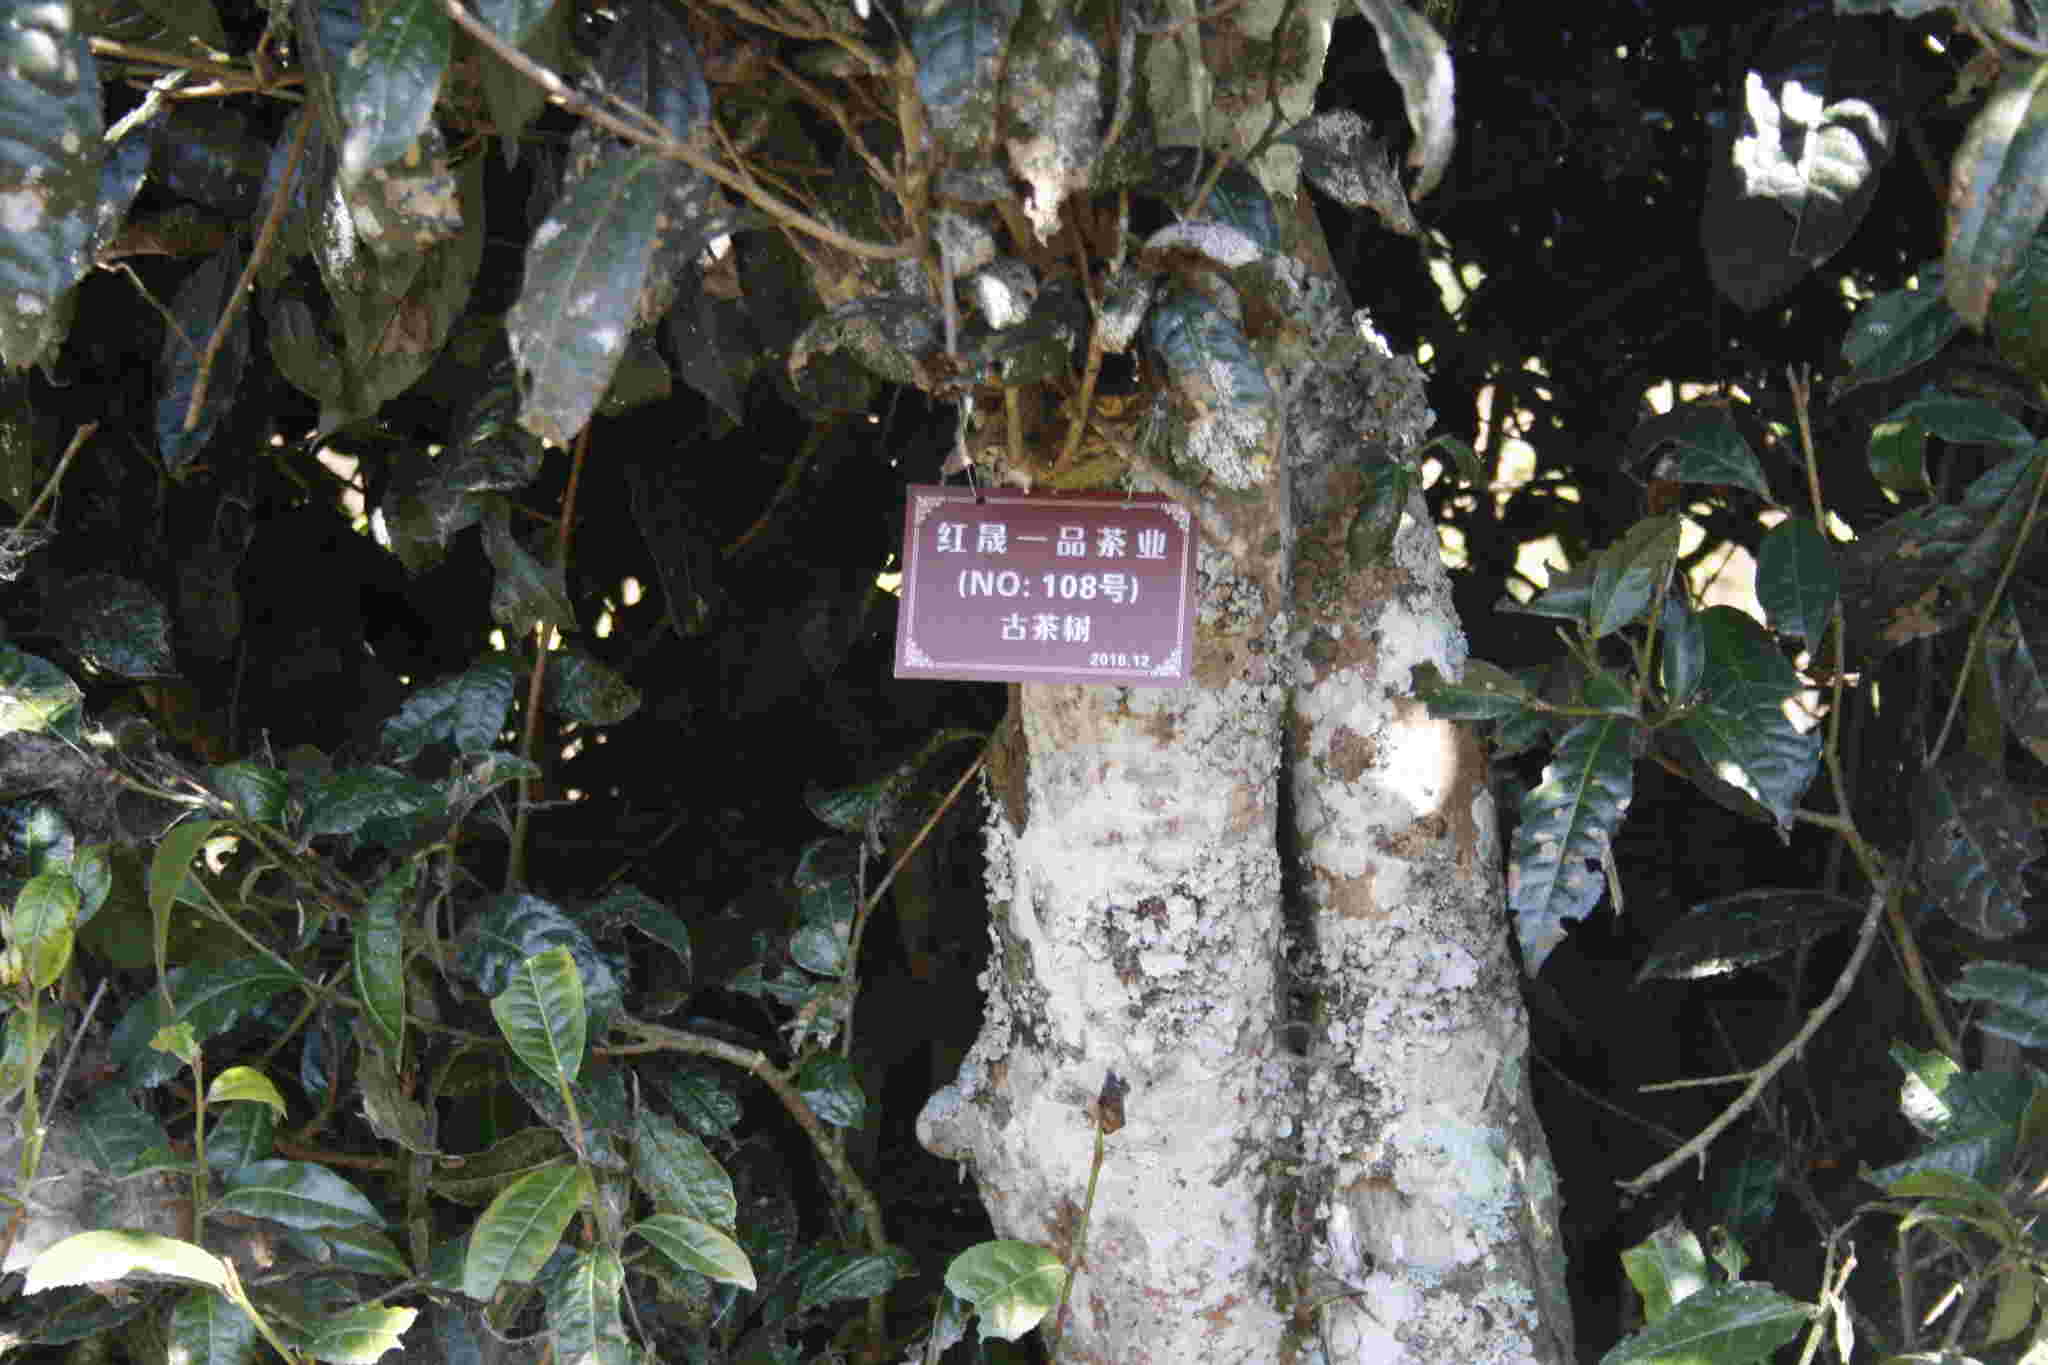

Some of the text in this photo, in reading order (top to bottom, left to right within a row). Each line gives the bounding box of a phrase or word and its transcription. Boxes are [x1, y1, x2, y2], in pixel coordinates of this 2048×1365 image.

[936, 522, 1167, 559] 红晟一品茶业
[1000, 614, 1091, 642] 古茶树
